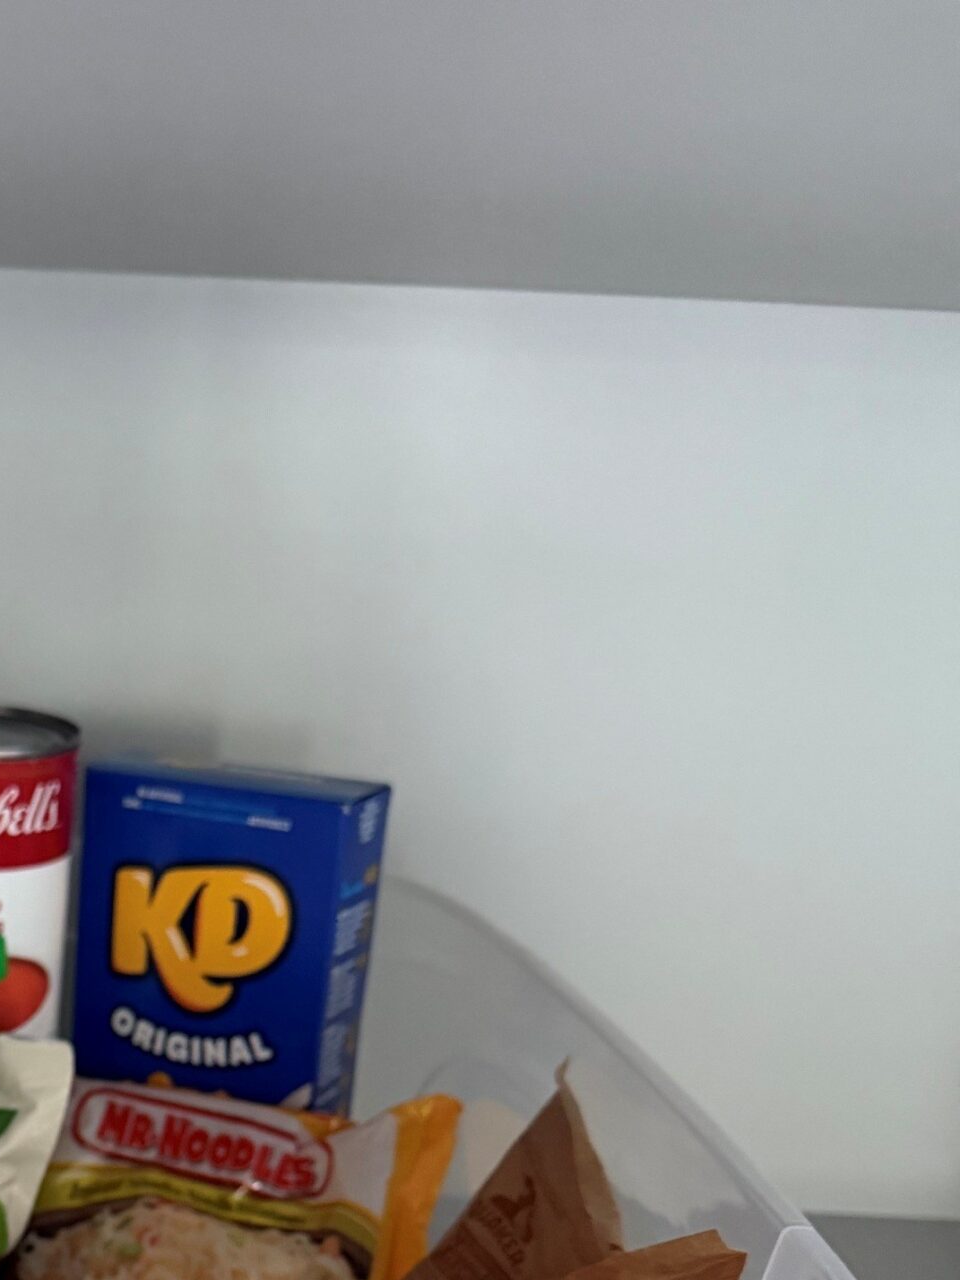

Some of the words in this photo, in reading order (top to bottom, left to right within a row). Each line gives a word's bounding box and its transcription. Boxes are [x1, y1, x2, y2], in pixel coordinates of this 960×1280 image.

[110, 864, 292, 1014] KD
[110, 1005, 275, 1068] ORIGINAL
[157, 1113, 317, 1190] NOODLES
